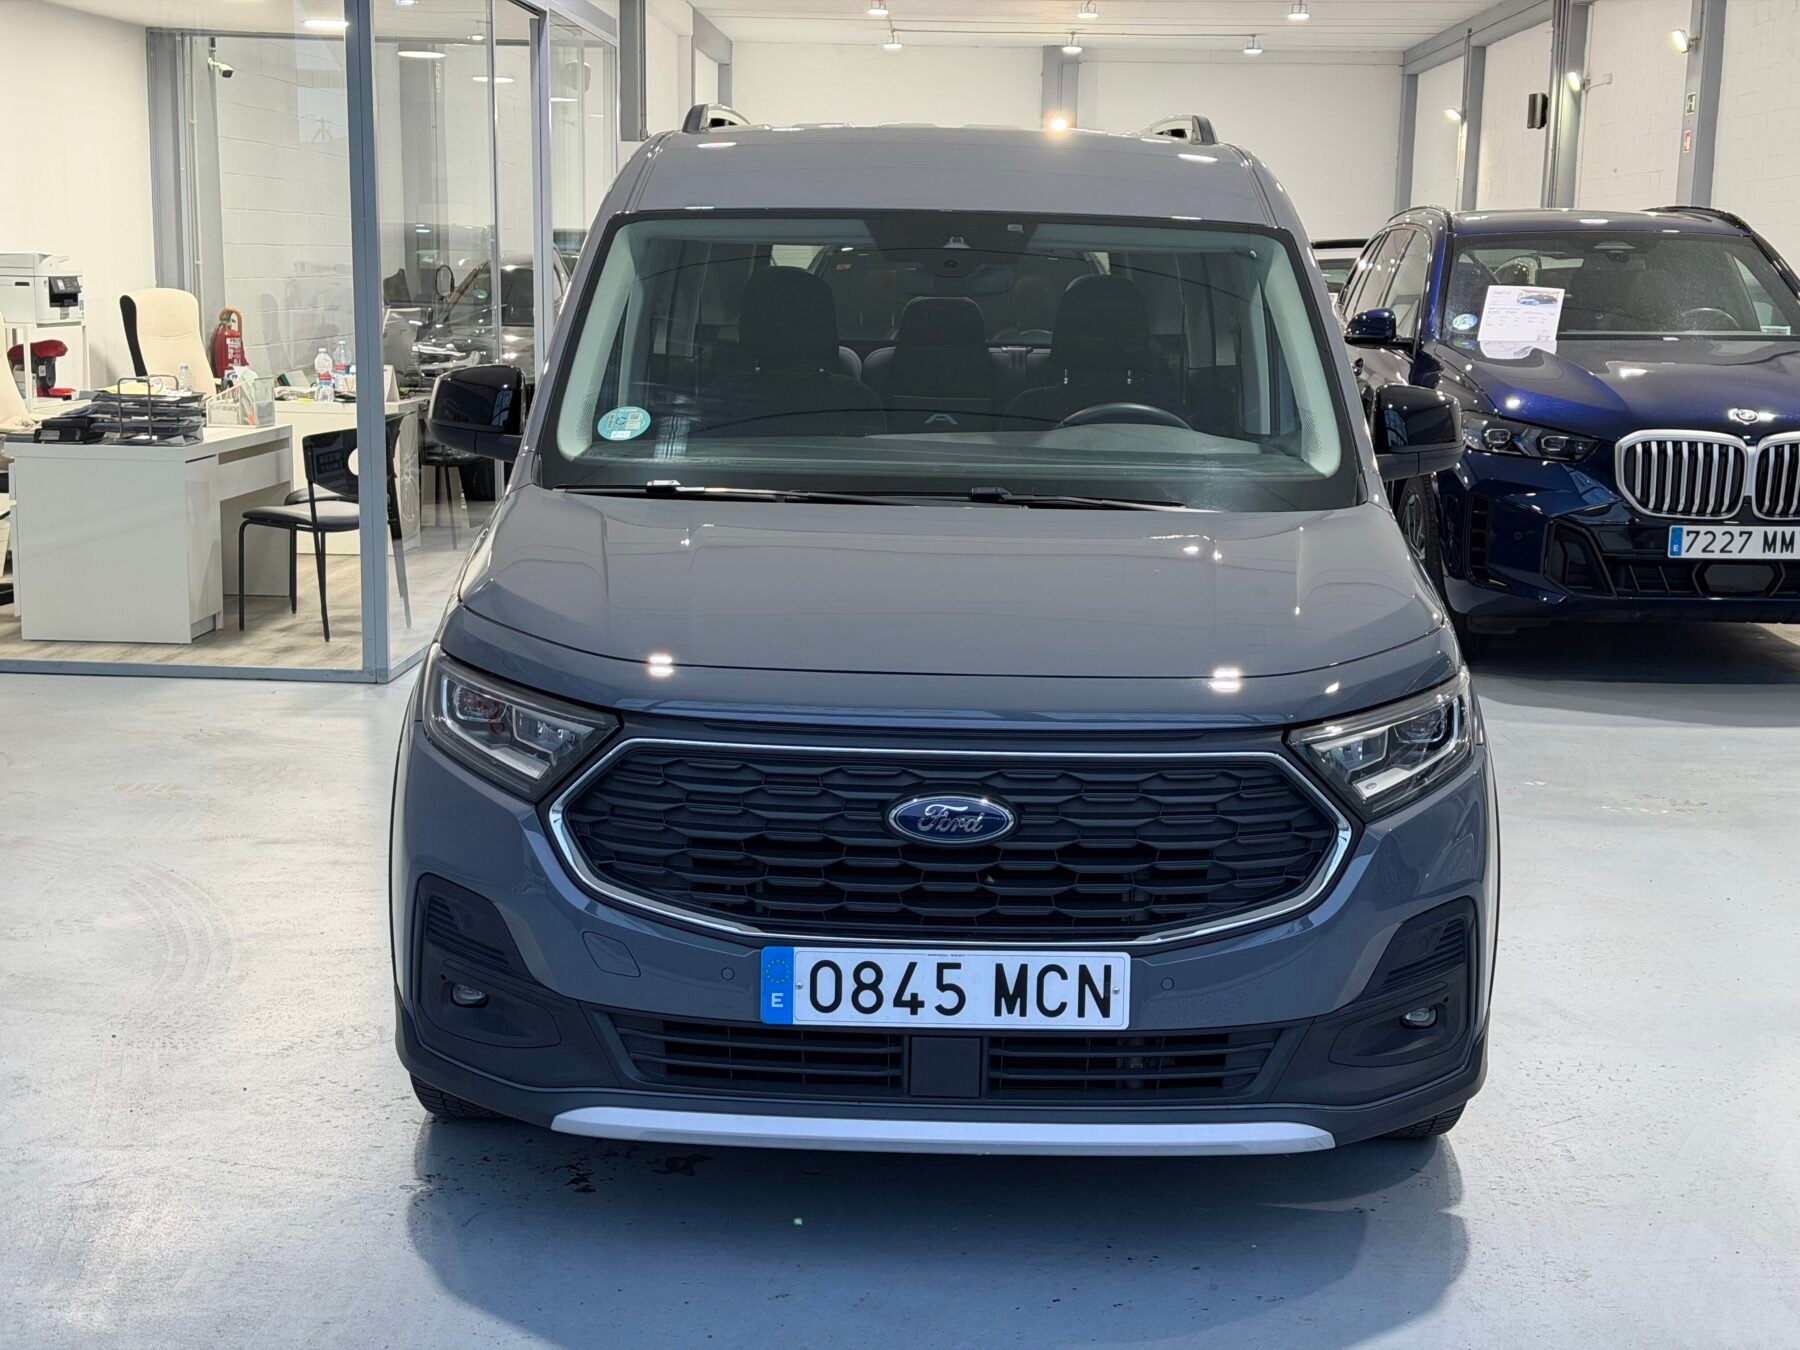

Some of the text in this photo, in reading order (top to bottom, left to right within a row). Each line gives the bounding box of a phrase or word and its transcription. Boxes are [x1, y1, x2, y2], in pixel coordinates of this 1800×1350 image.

[1673, 544, 1679, 552] E
[1684, 530, 1800, 554] 7227 MM
[917, 804, 985, 833] Ford
[770, 992, 784, 1009] E
[809, 959, 1112, 1019] 0845 MCN
